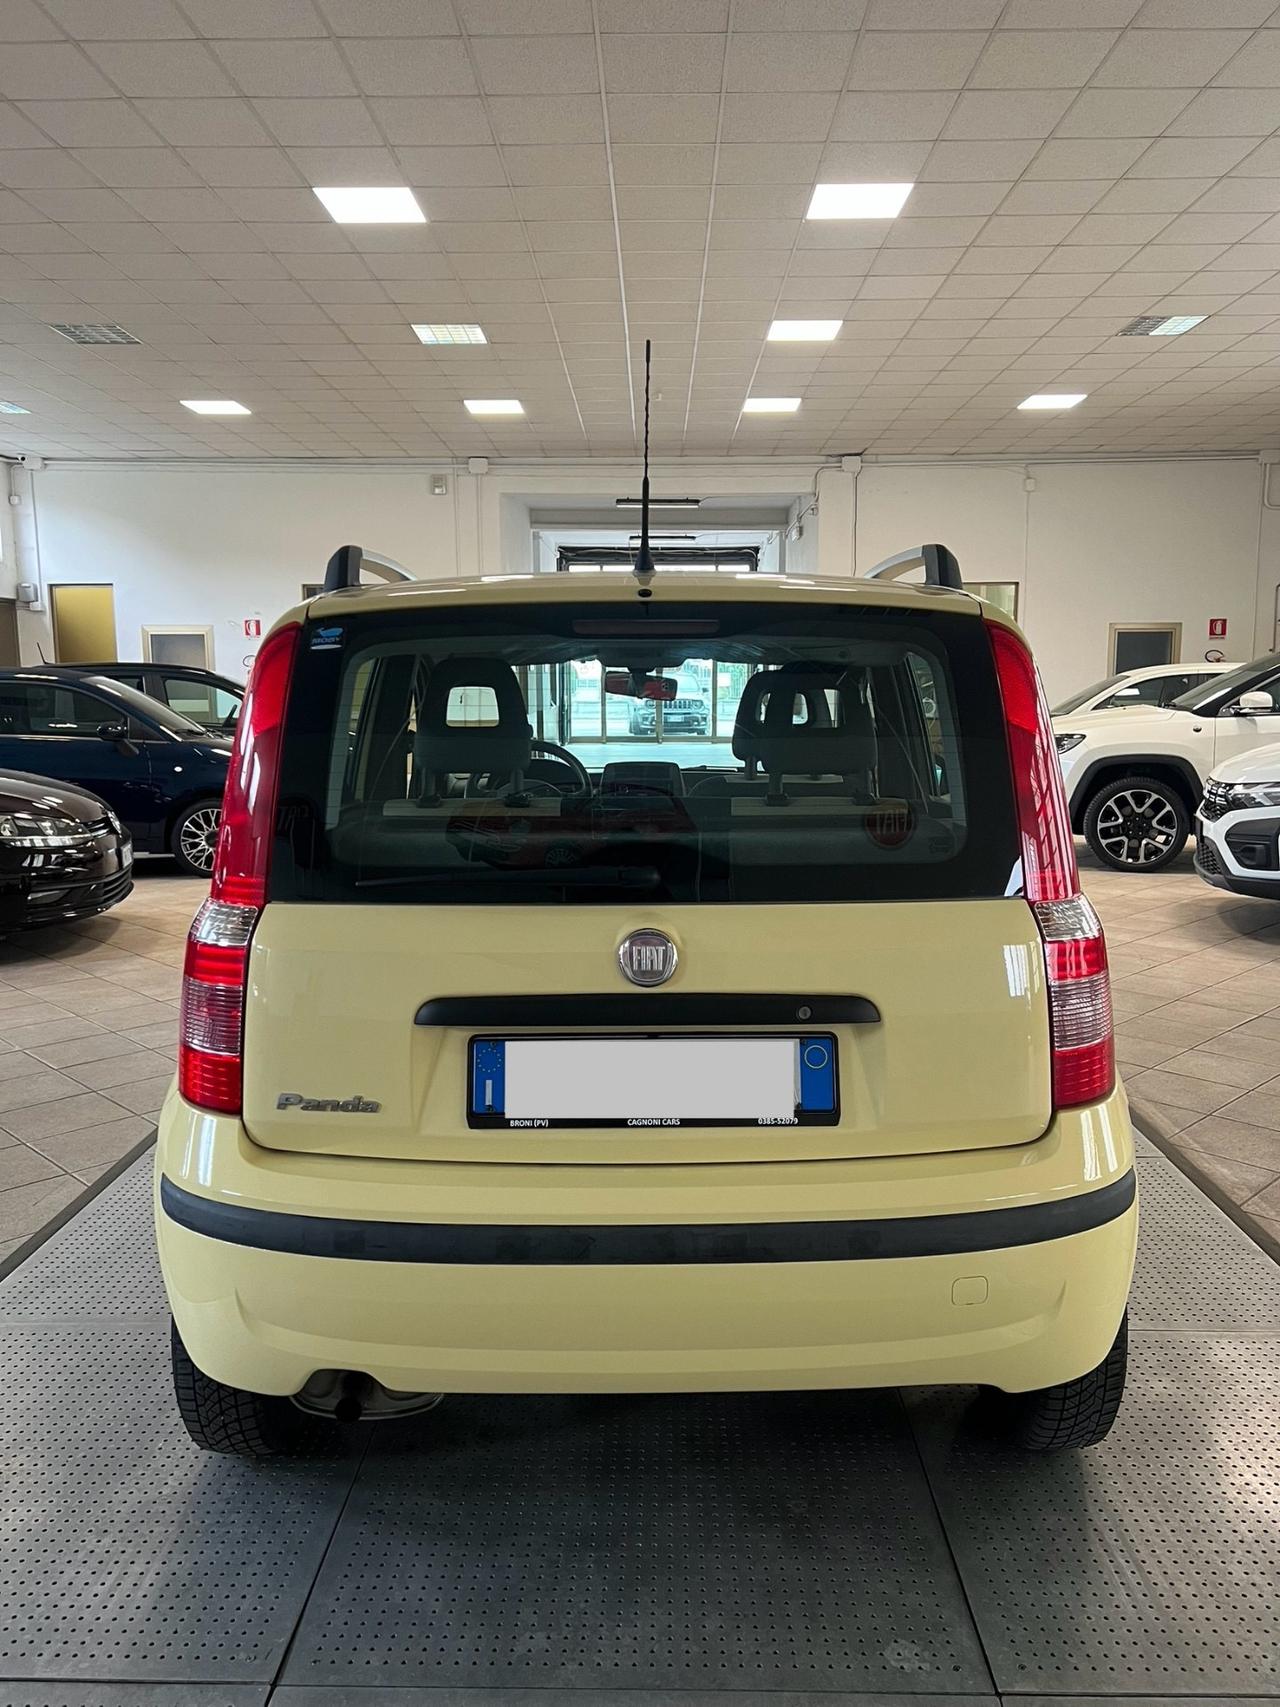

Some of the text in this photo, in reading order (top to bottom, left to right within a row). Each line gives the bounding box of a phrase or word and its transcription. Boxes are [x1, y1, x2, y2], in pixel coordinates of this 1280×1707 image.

[632, 946, 666, 971] FIAT
[276, 1092, 382, 1113] Panda
[509, 1118, 549, 1128] BRONI (PV)
[627, 1118, 681, 1127] CAGNONI CARS
[757, 1117, 799, 1125] 0385-52079
